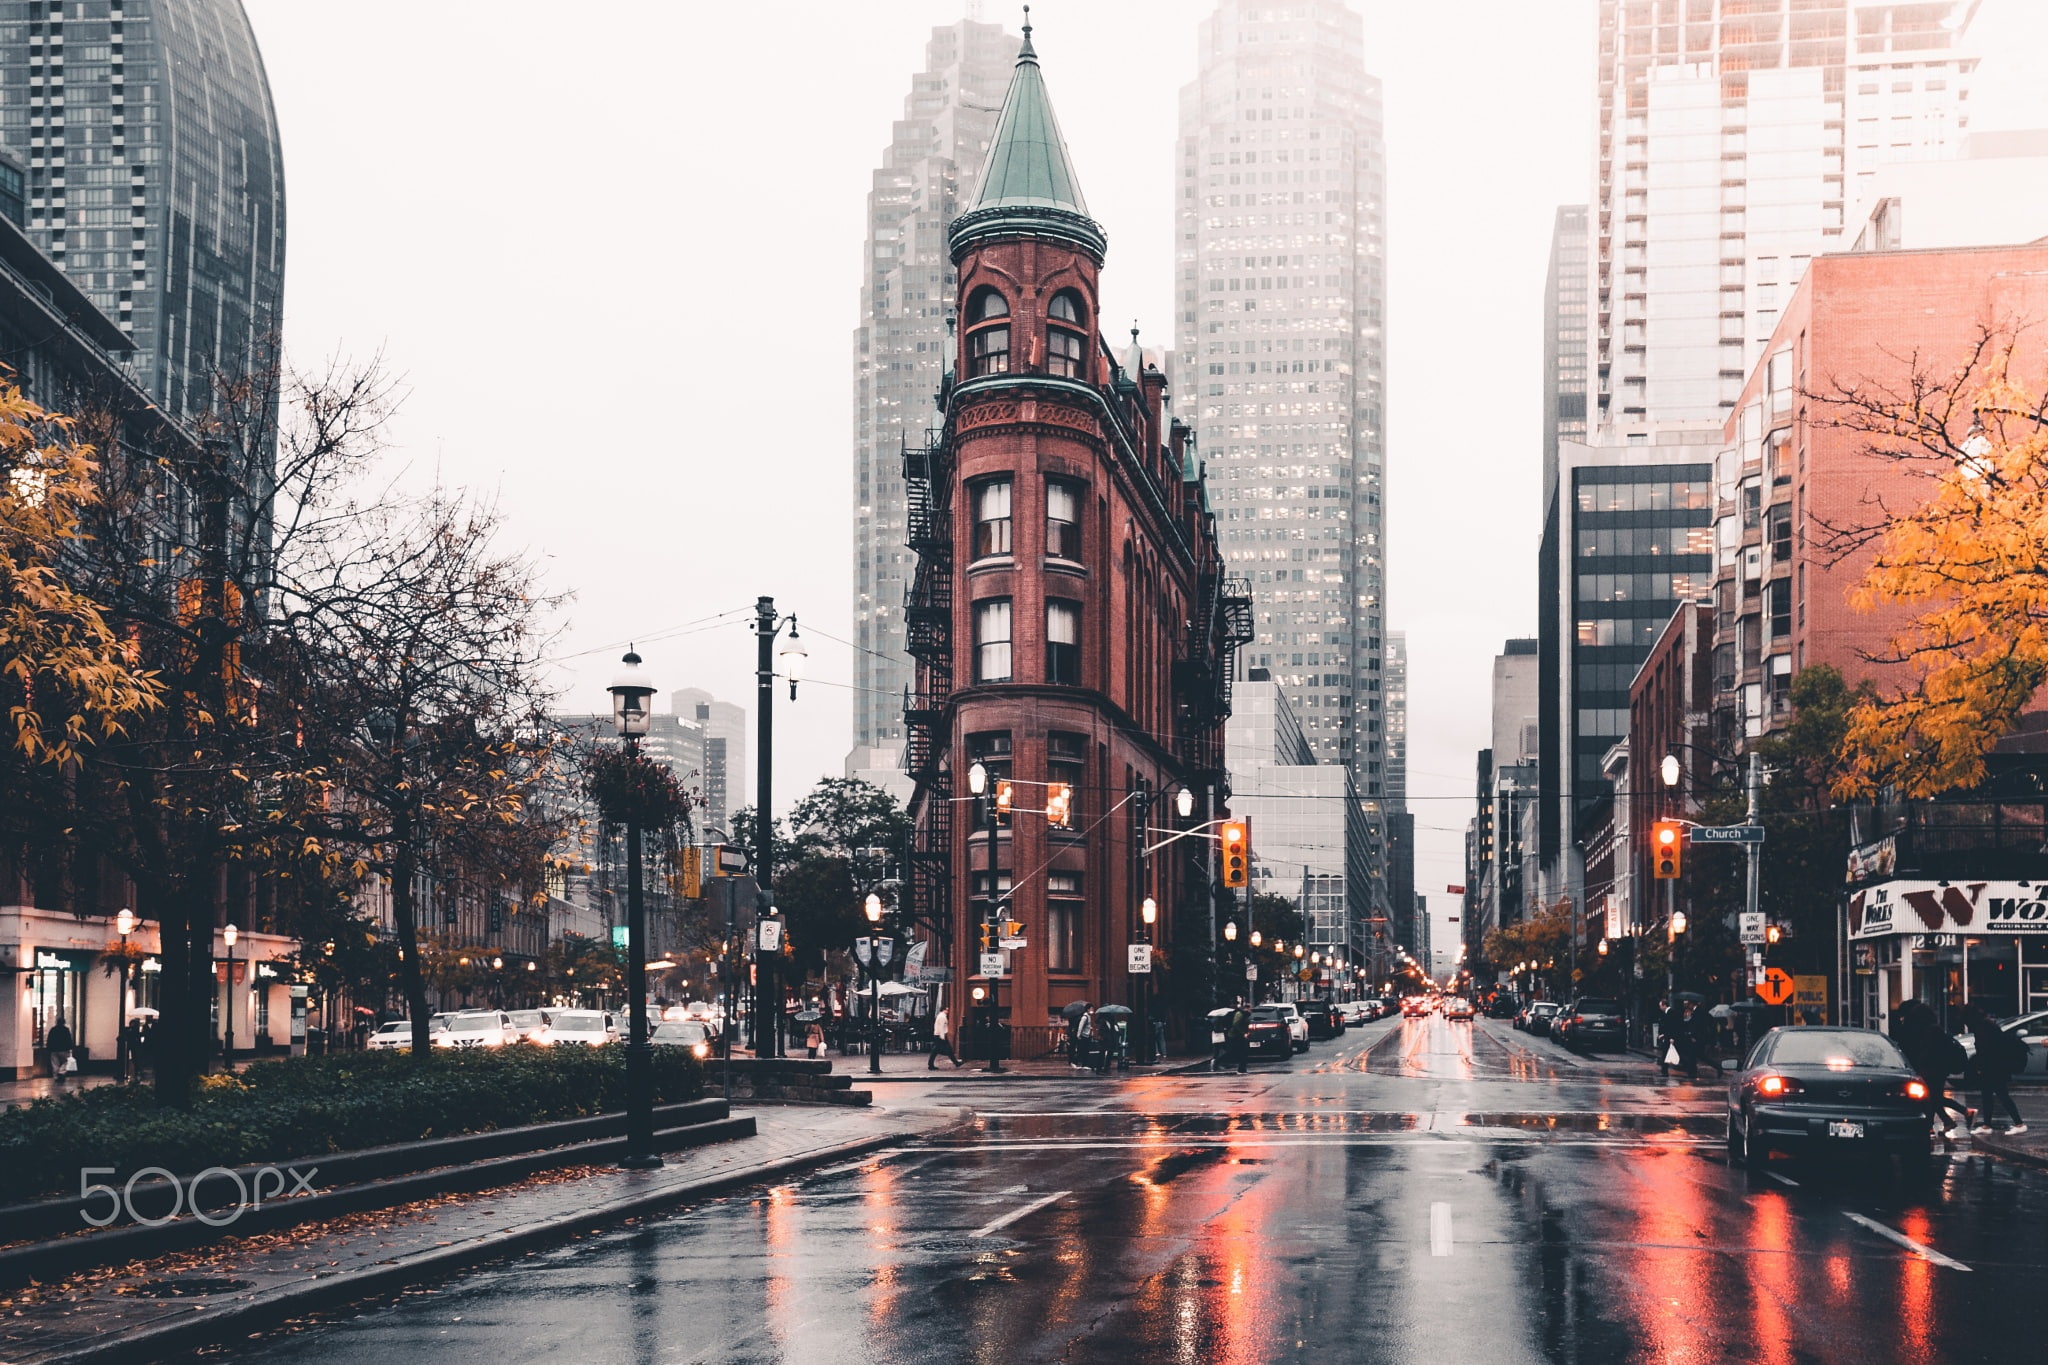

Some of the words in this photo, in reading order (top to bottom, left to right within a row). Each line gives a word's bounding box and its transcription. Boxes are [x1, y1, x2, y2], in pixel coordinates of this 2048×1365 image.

[1705, 829, 1741, 839] Church
[1865, 904, 1893, 925] WORKS
[1901, 883, 1987, 930] W
